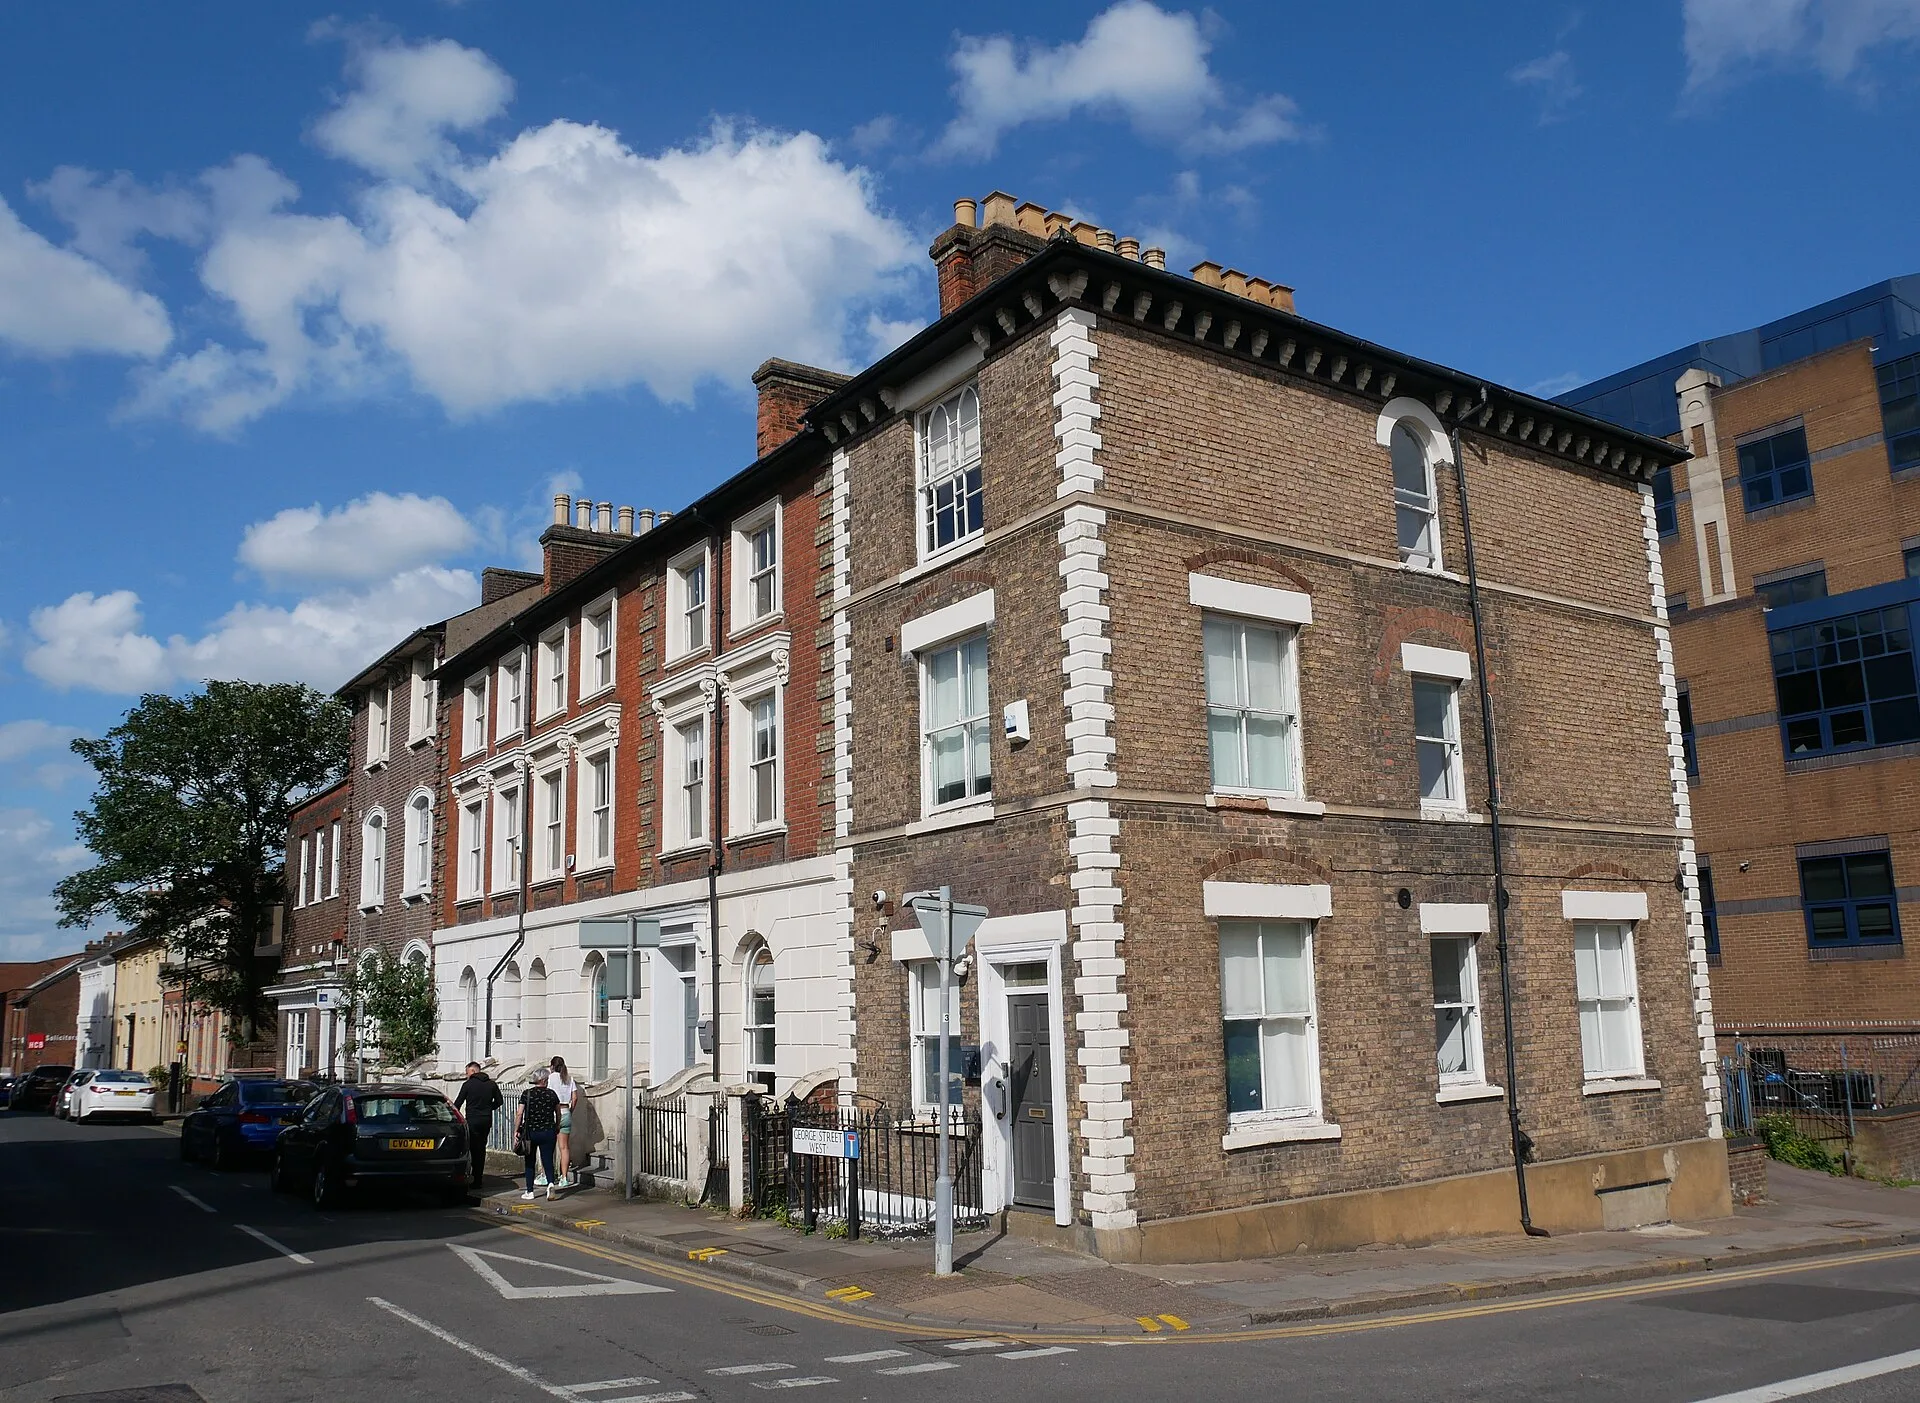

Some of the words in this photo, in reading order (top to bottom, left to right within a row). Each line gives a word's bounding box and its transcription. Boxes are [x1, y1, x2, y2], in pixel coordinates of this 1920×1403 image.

[1445, 1008, 1453, 1020] 2
[28, 1041, 44, 1049] HCB
[794, 1128, 816, 1141] GEORGE
[819, 1131, 842, 1144] STREET
[392, 1140, 413, 1148] CV07
[415, 1140, 431, 1148] NZY
[809, 1143, 827, 1154] WEST
